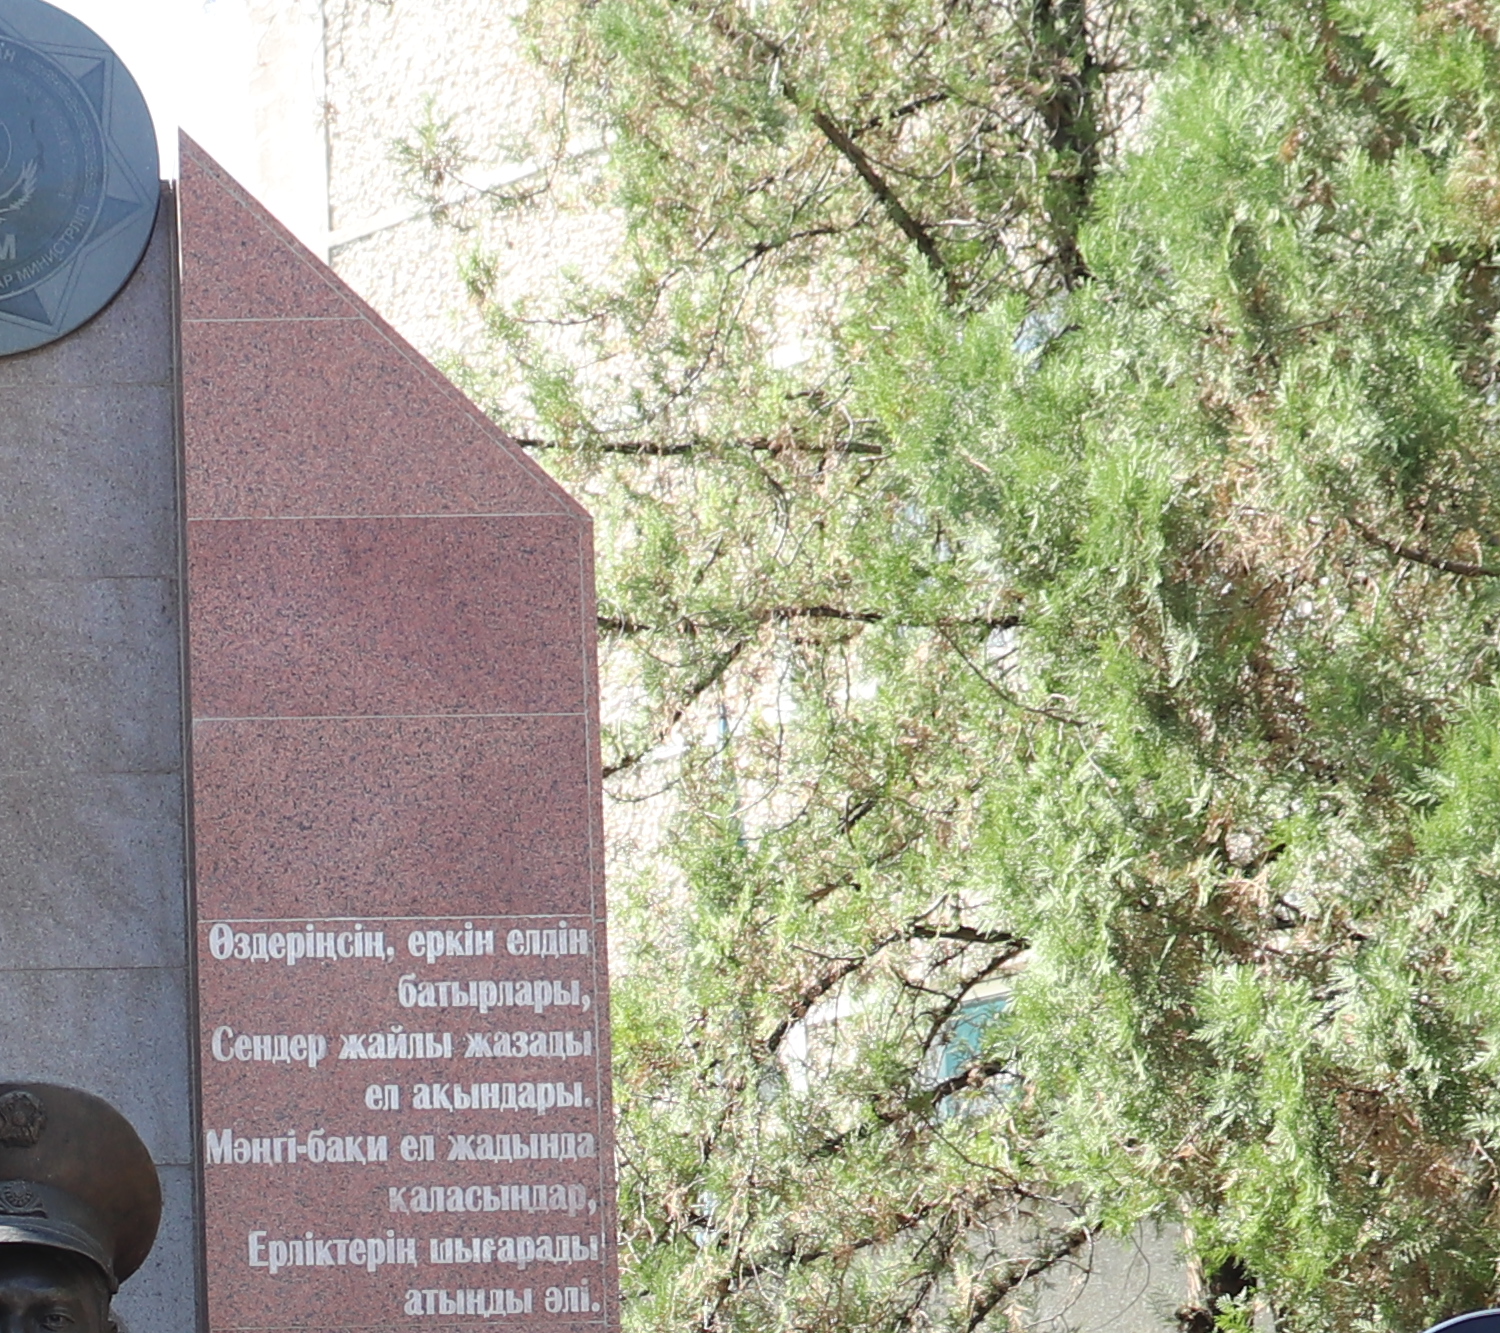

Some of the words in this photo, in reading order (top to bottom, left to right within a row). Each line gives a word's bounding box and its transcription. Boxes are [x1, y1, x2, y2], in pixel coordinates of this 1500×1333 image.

[407, 921, 495, 963] еркін
[398, 973, 592, 1013] батырлары,
[211, 1025, 327, 1067] Сендер
[338, 1024, 453, 1060] жайлы
[463, 1029, 592, 1060] жазады
[365, 1082, 400, 1110] ел
[413, 1081, 593, 1115] ақындары.
[205, 1128, 388, 1166] Мәңгі-бақи
[400, 1135, 435, 1162] ел
[447, 1131, 597, 1163] жадында
[248, 1229, 417, 1274] Ерліктерің
[429, 1234, 600, 1270] шығарады
[544, 1278, 601, 1314] әлі.
